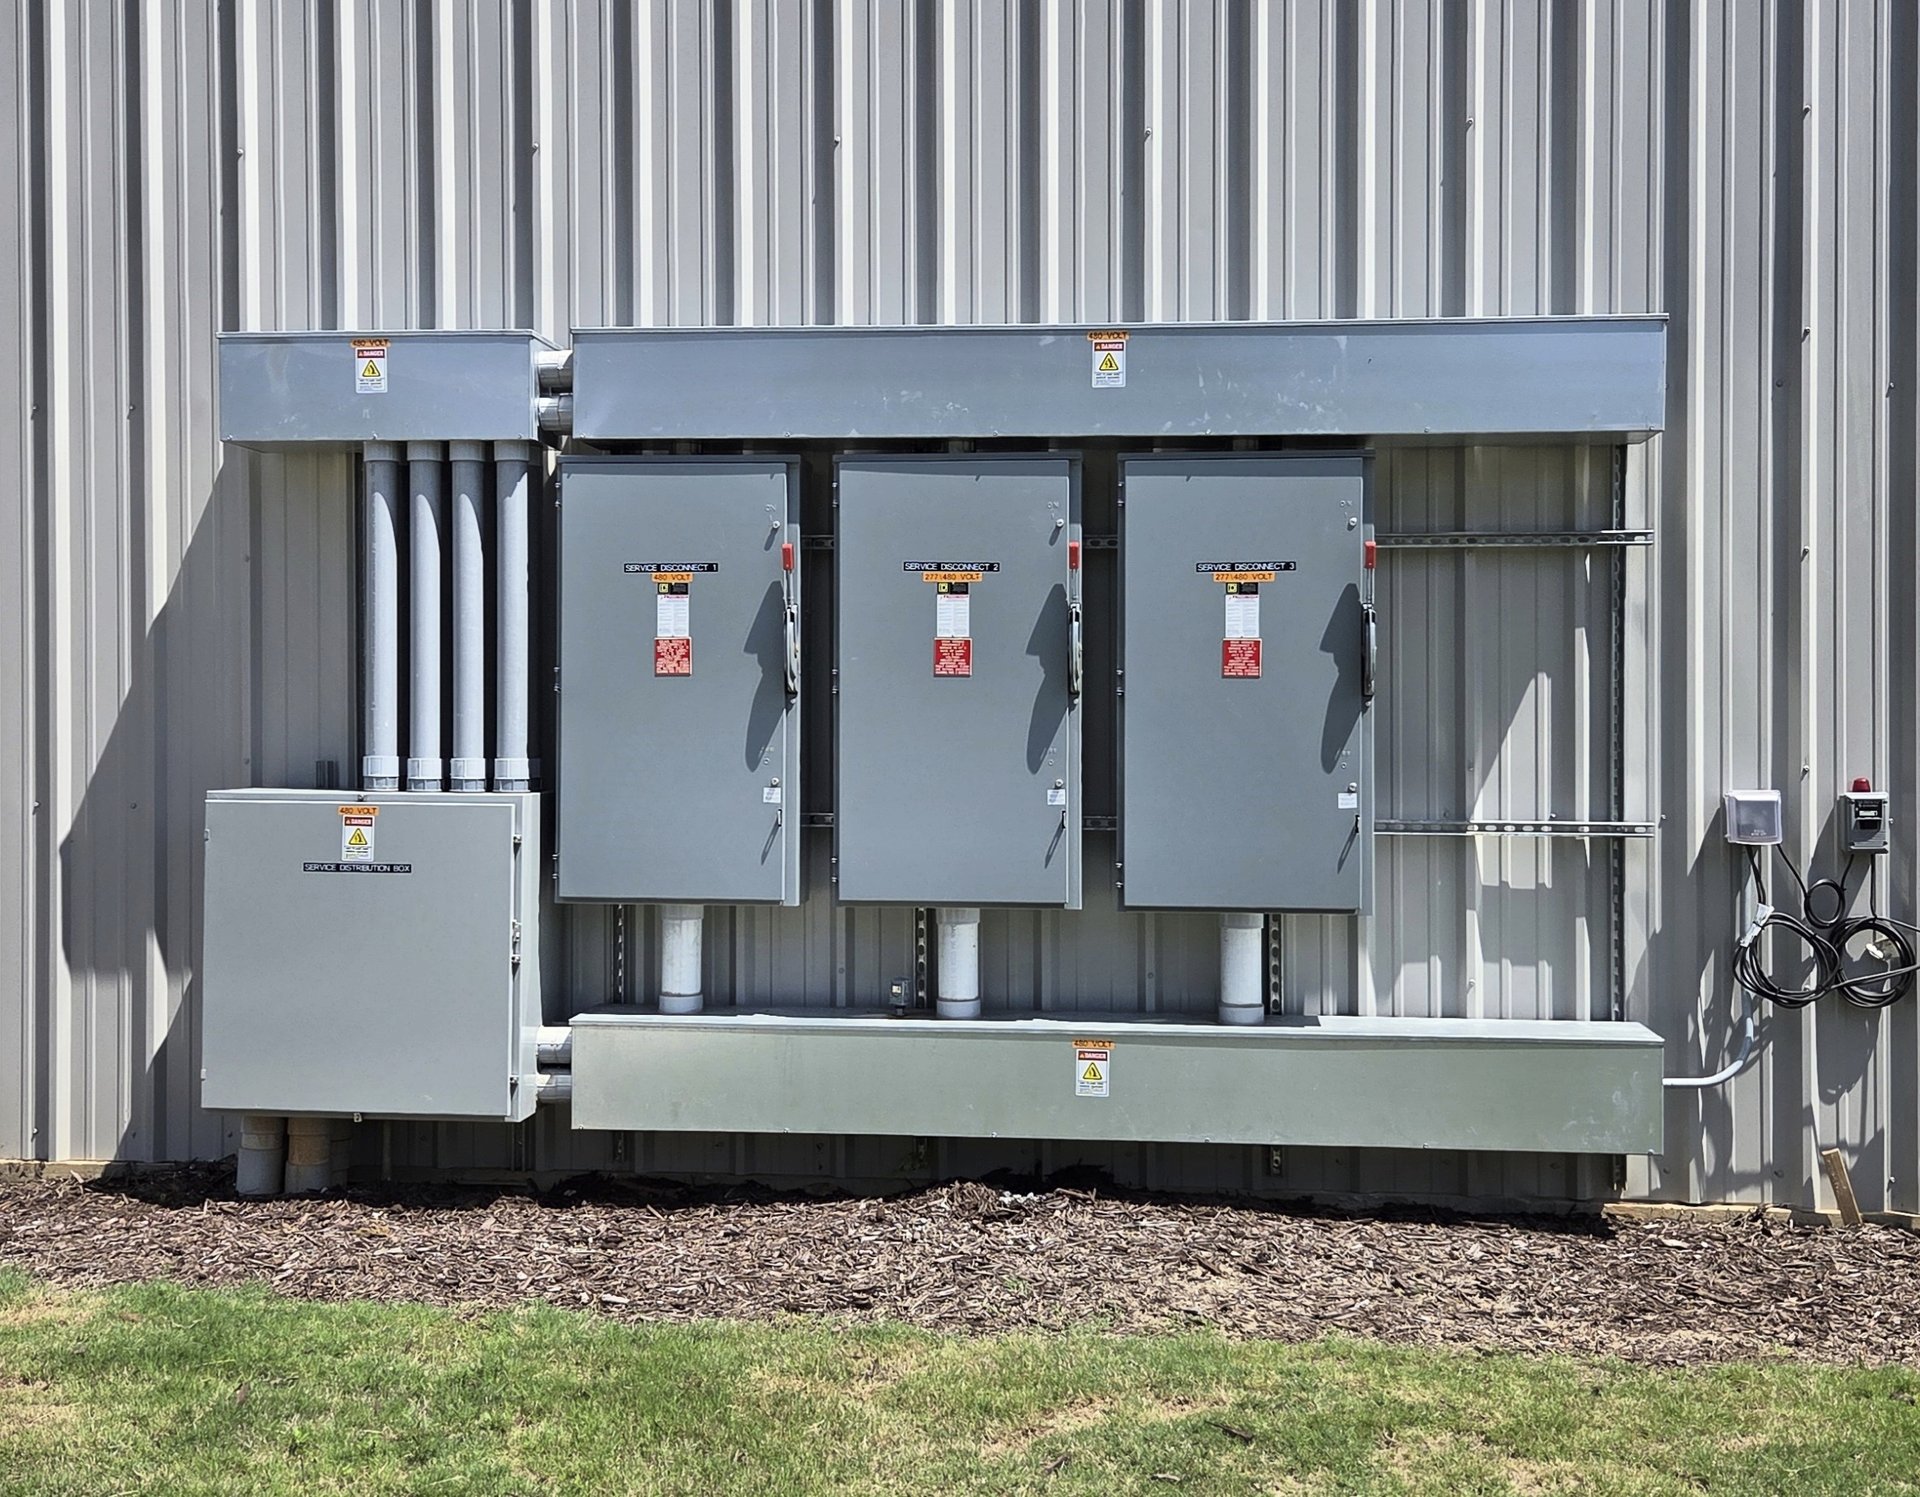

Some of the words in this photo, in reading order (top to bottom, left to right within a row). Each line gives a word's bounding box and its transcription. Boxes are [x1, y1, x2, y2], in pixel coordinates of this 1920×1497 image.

[1088, 331, 1103, 340] 480
[1106, 331, 1127, 340] VOLT
[369, 339, 389, 347] VOLT
[625, 563, 657, 572] SERVICE
[660, 563, 708, 572] DISCONNECT
[904, 562, 938, 571] SERVICE
[940, 563, 990, 571] DISCONNECT
[993, 563, 999, 571] 2
[1197, 563, 1231, 572] SERVICE
[1234, 562, 1286, 571] DISCONNECT
[1289, 562, 1295, 570] 3
[653, 573, 668, 581] 480
[671, 573, 691, 581] VOLT
[960, 573, 981, 581] VOLT
[1252, 573, 1273, 581] VOLT
[339, 807, 353, 815] 480
[357, 807, 378, 815] VOLT
[304, 863, 337, 872] SERVICE
[339, 864, 391, 872] DISTRIBUTION
[393, 864, 410, 873] BOX
[1073, 1040, 1088, 1048] 480
[1091, 1040, 1112, 1048] VOLT
